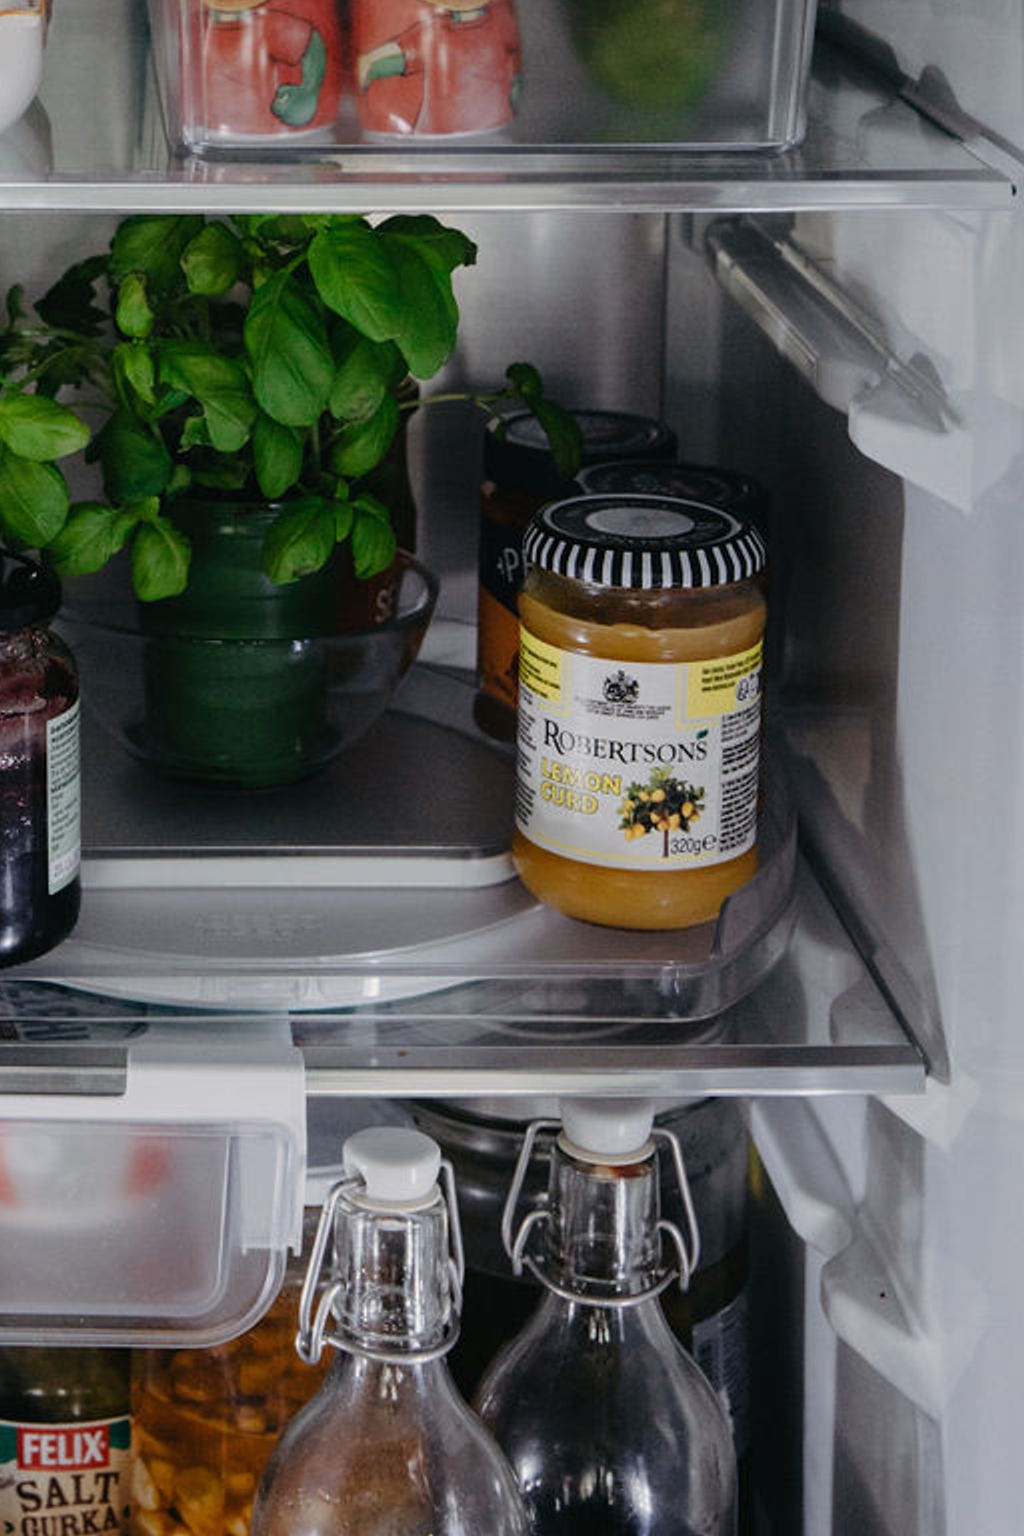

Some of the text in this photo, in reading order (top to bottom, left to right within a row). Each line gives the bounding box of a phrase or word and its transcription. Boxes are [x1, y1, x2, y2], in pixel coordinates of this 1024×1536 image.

[540, 756, 623, 796] LEMON
[540, 781, 599, 815] CURD
[23, 1430, 103, 1466] FELIX
[16, 1472, 120, 1513] SALT
